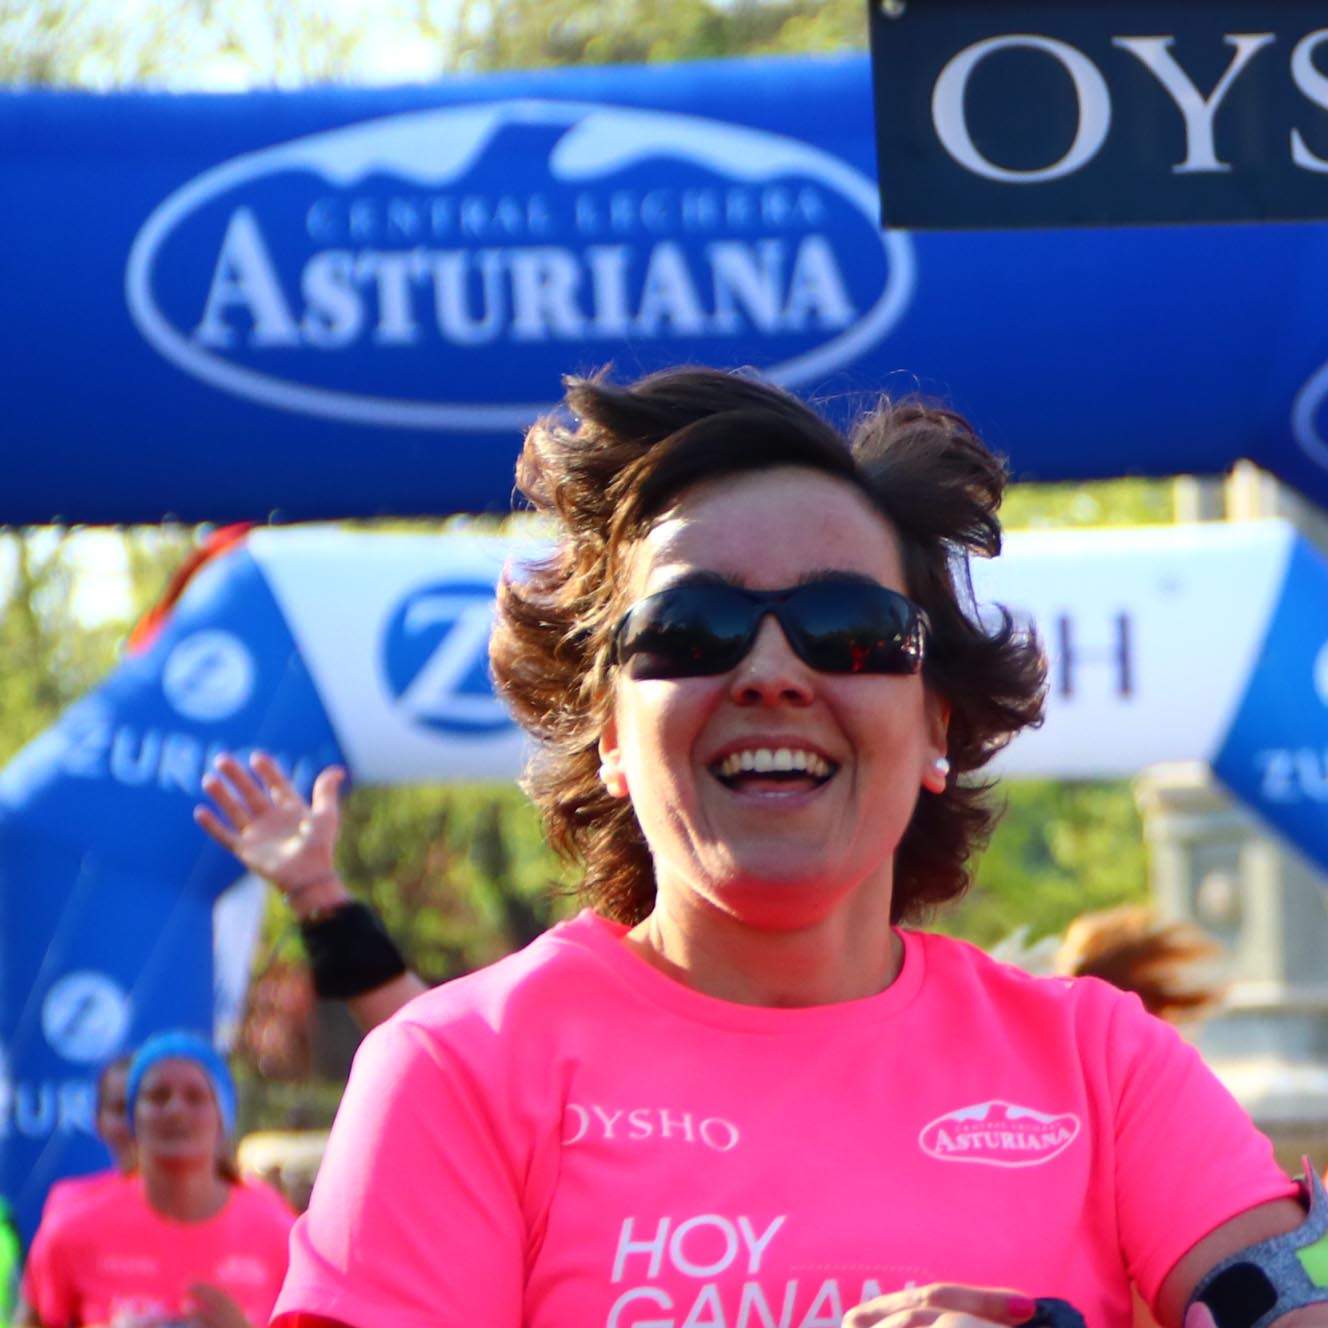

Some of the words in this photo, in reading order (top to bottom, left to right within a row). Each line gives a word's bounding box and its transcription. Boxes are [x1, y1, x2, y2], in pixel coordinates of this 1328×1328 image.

[194, 204, 857, 348] ASTURIANA
[935, 1126, 1072, 1153] ASTURIANA
[611, 1214, 788, 1283] HOY
